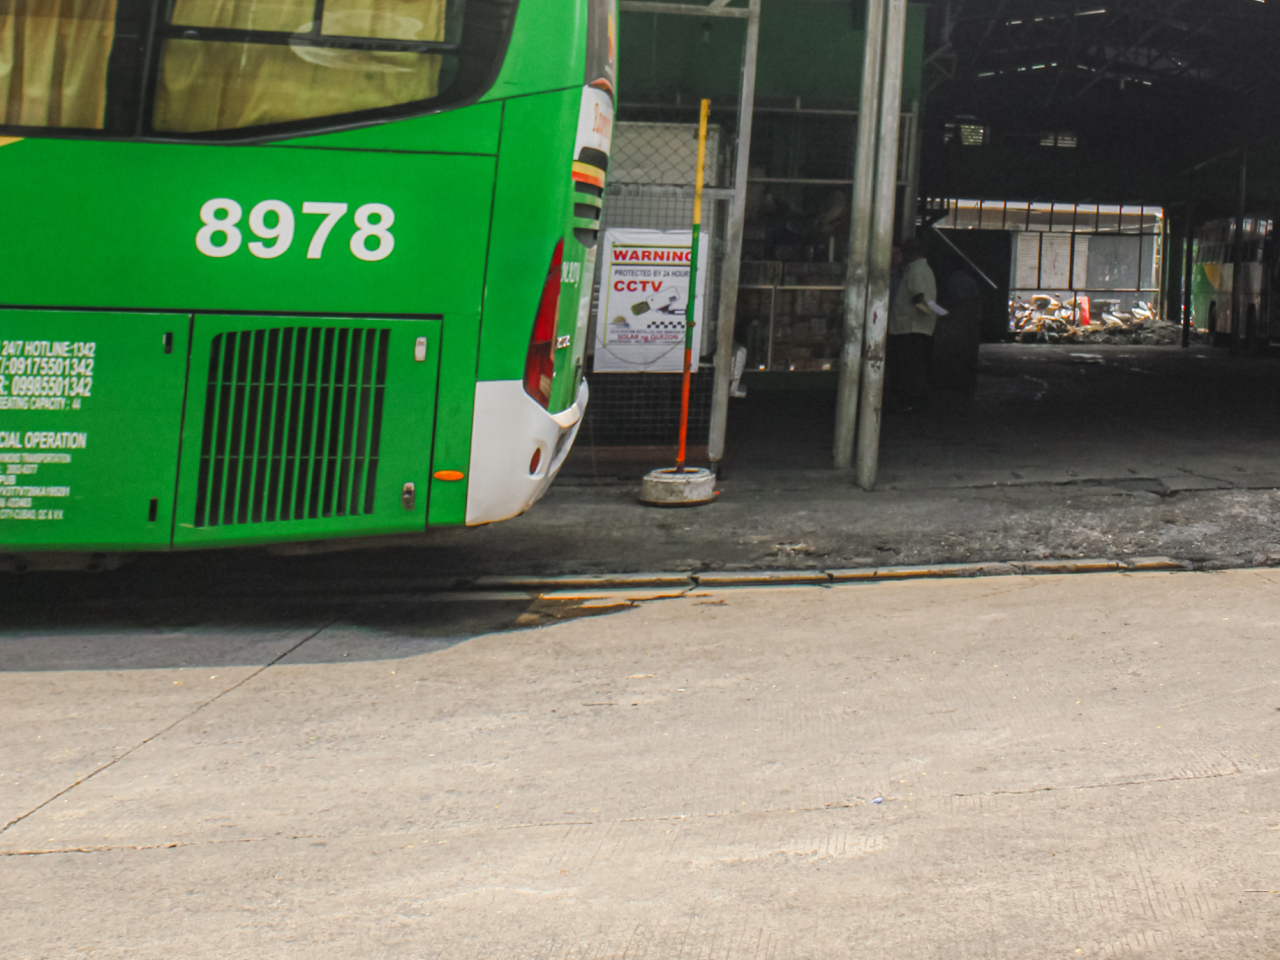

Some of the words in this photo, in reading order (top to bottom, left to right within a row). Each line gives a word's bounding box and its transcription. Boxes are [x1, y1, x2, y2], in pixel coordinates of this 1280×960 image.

[195, 197, 395, 262] 8978
[614, 269, 652, 278] PROTECTED
[653, 270, 661, 278] BY
[663, 270, 670, 278] 24
[613, 280, 663, 292] CCTV
[12, 376, 92, 397] 09985501342
[30, 396, 66, 410] CAPACITY
[24, 431, 87, 449] OPERATION
